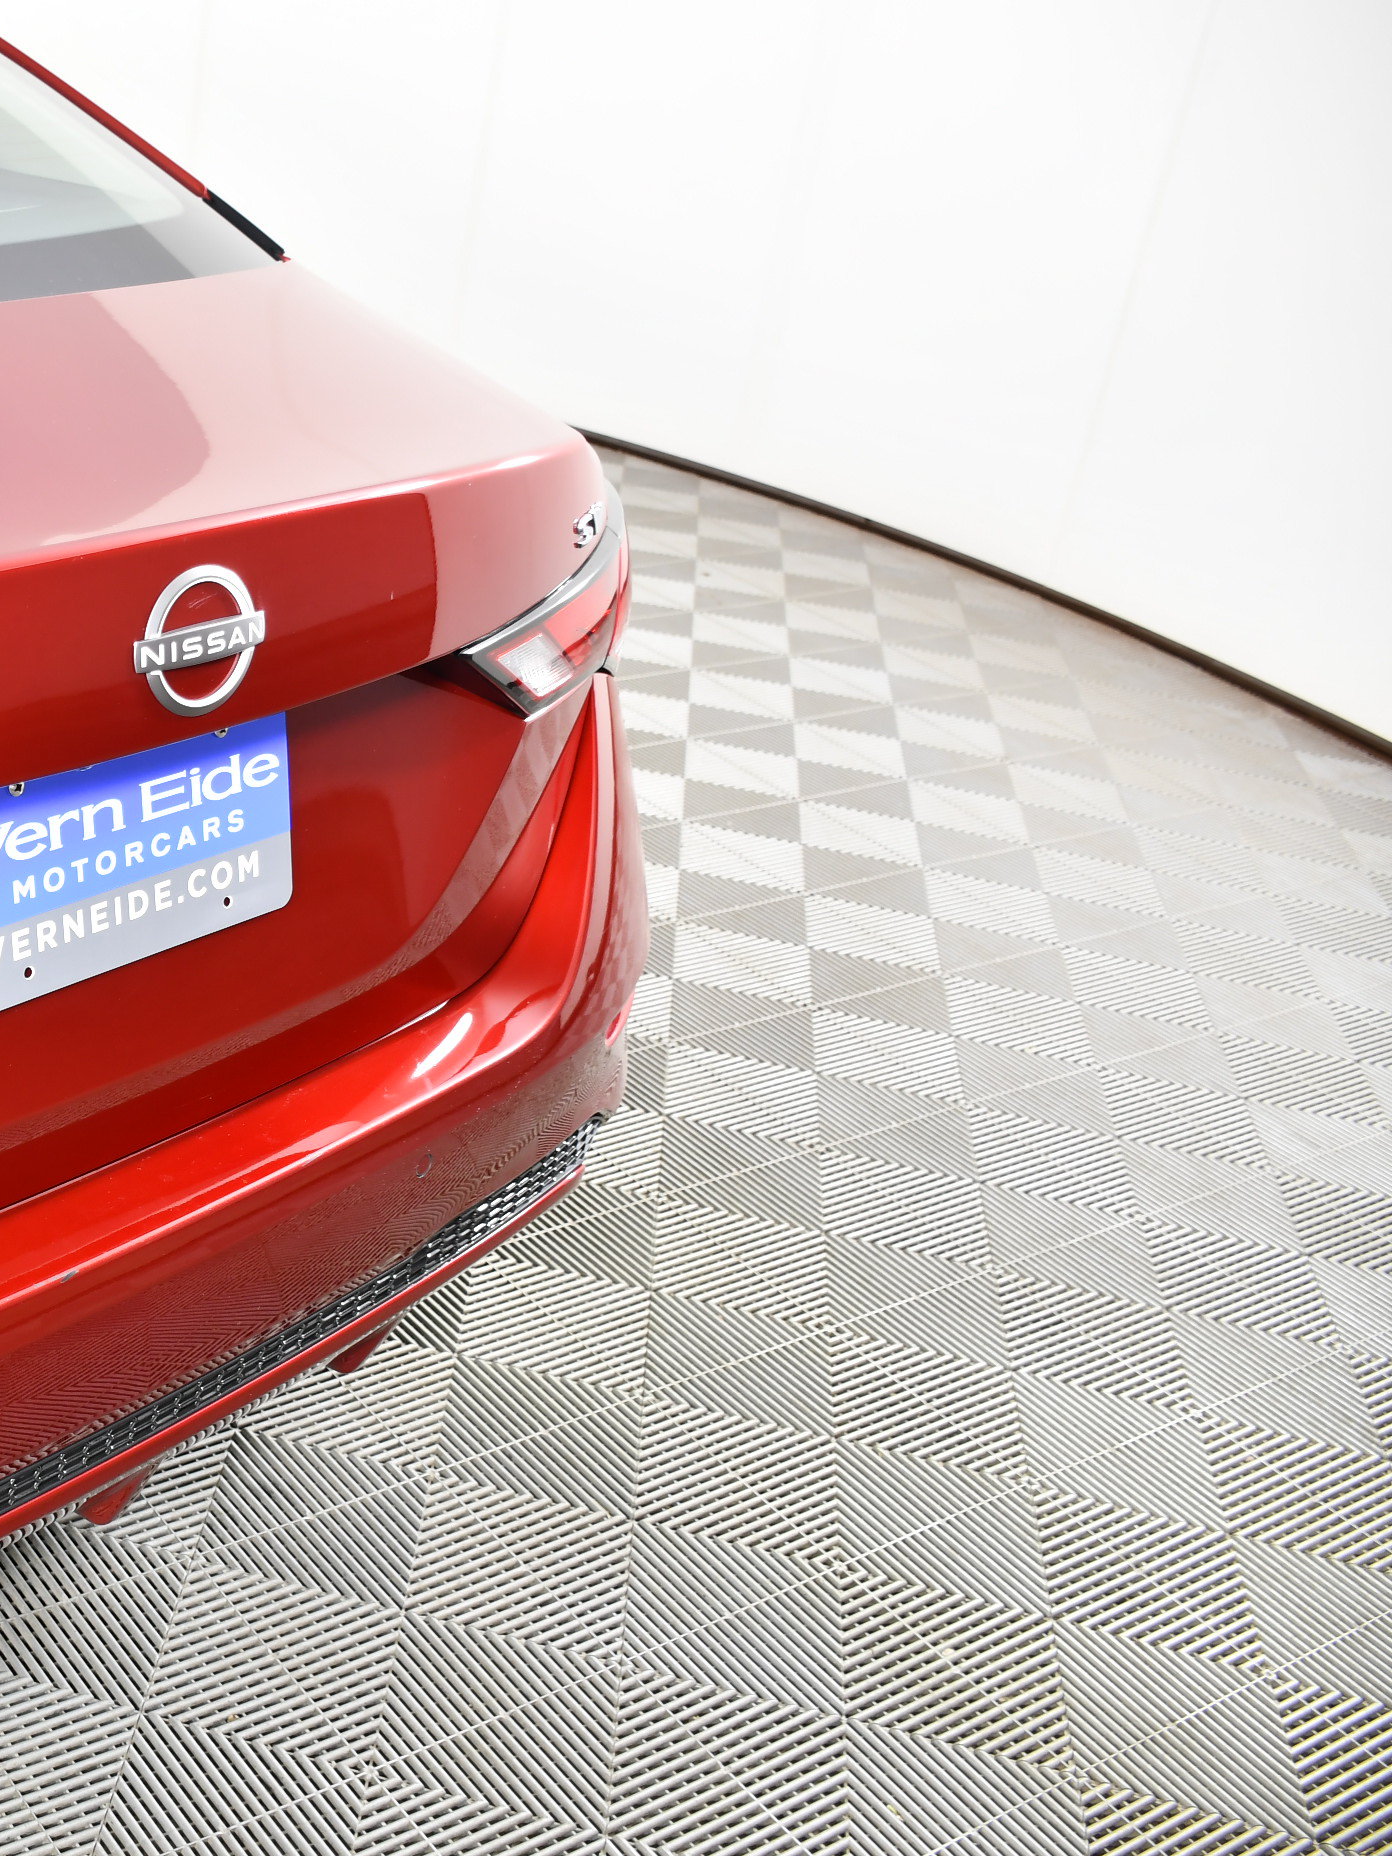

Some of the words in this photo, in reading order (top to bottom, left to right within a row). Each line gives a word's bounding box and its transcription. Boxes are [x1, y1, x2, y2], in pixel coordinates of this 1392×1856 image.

[139, 615, 265, 671] NISSAN
[138, 752, 281, 824] Eide
[12, 808, 246, 905] MOTORCARS
